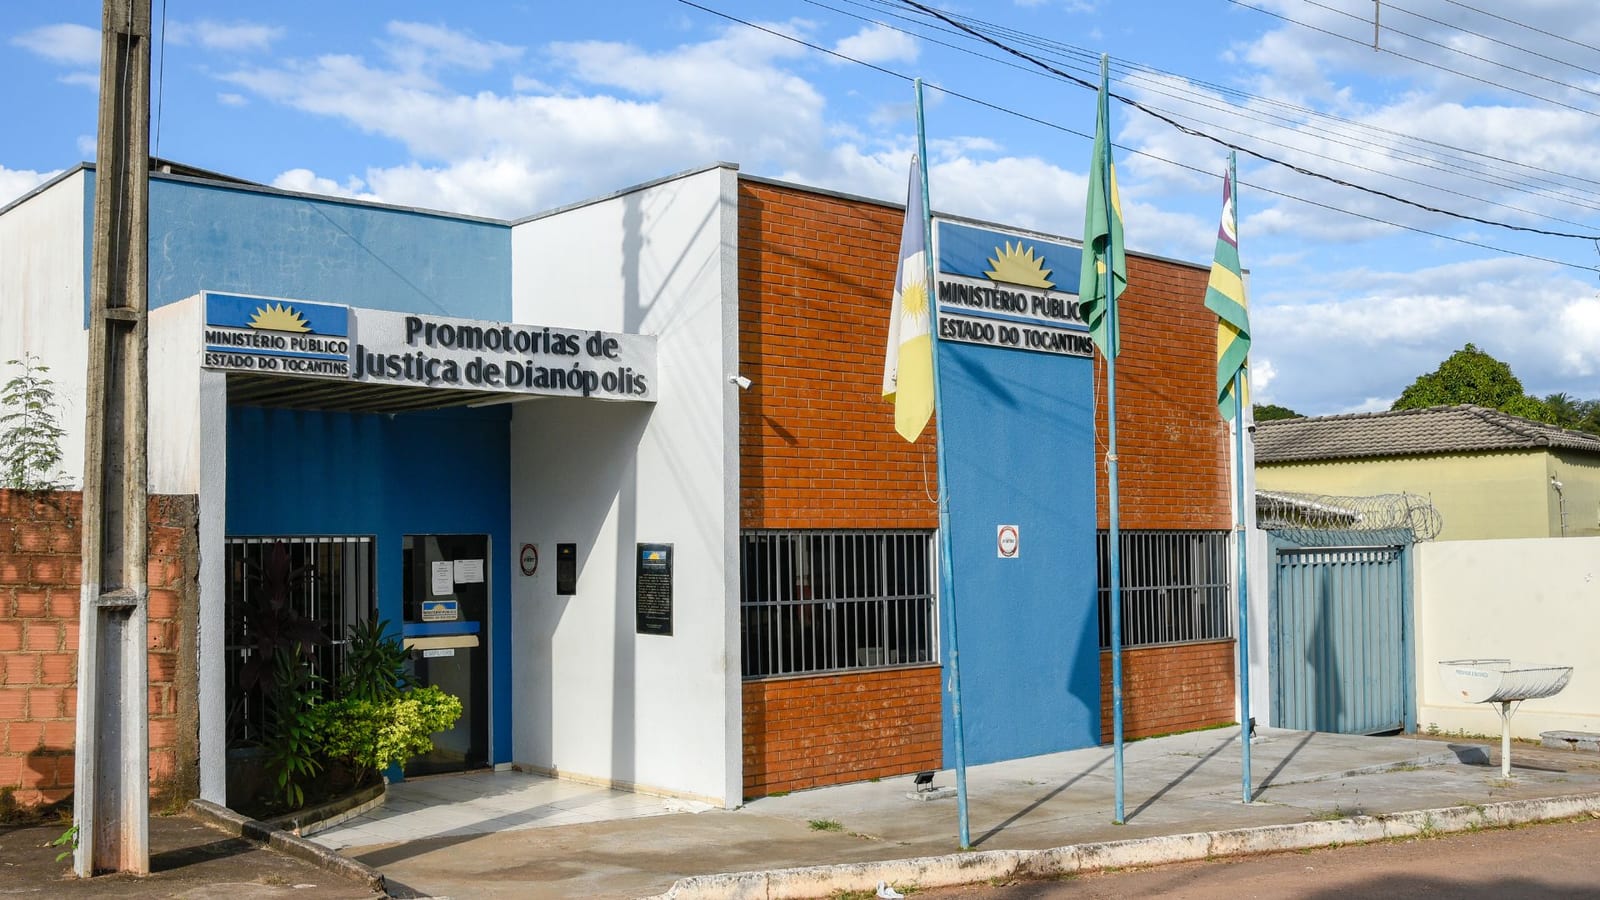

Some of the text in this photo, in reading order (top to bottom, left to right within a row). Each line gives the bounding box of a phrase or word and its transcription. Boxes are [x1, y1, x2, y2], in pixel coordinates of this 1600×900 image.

[938, 281, 1081, 321] MINISTÉRIO PÚBLIC
[205, 330, 348, 354] MINISTÉRIO PÚBLICO
[405, 316, 619, 359] Promotorias de
[939, 317, 1093, 354] ESTADO DO TOCANTINS
[205, 353, 348, 375] ESTADO DO TOCANTINS
[352, 344, 647, 397] Justiça de Dianópolis
